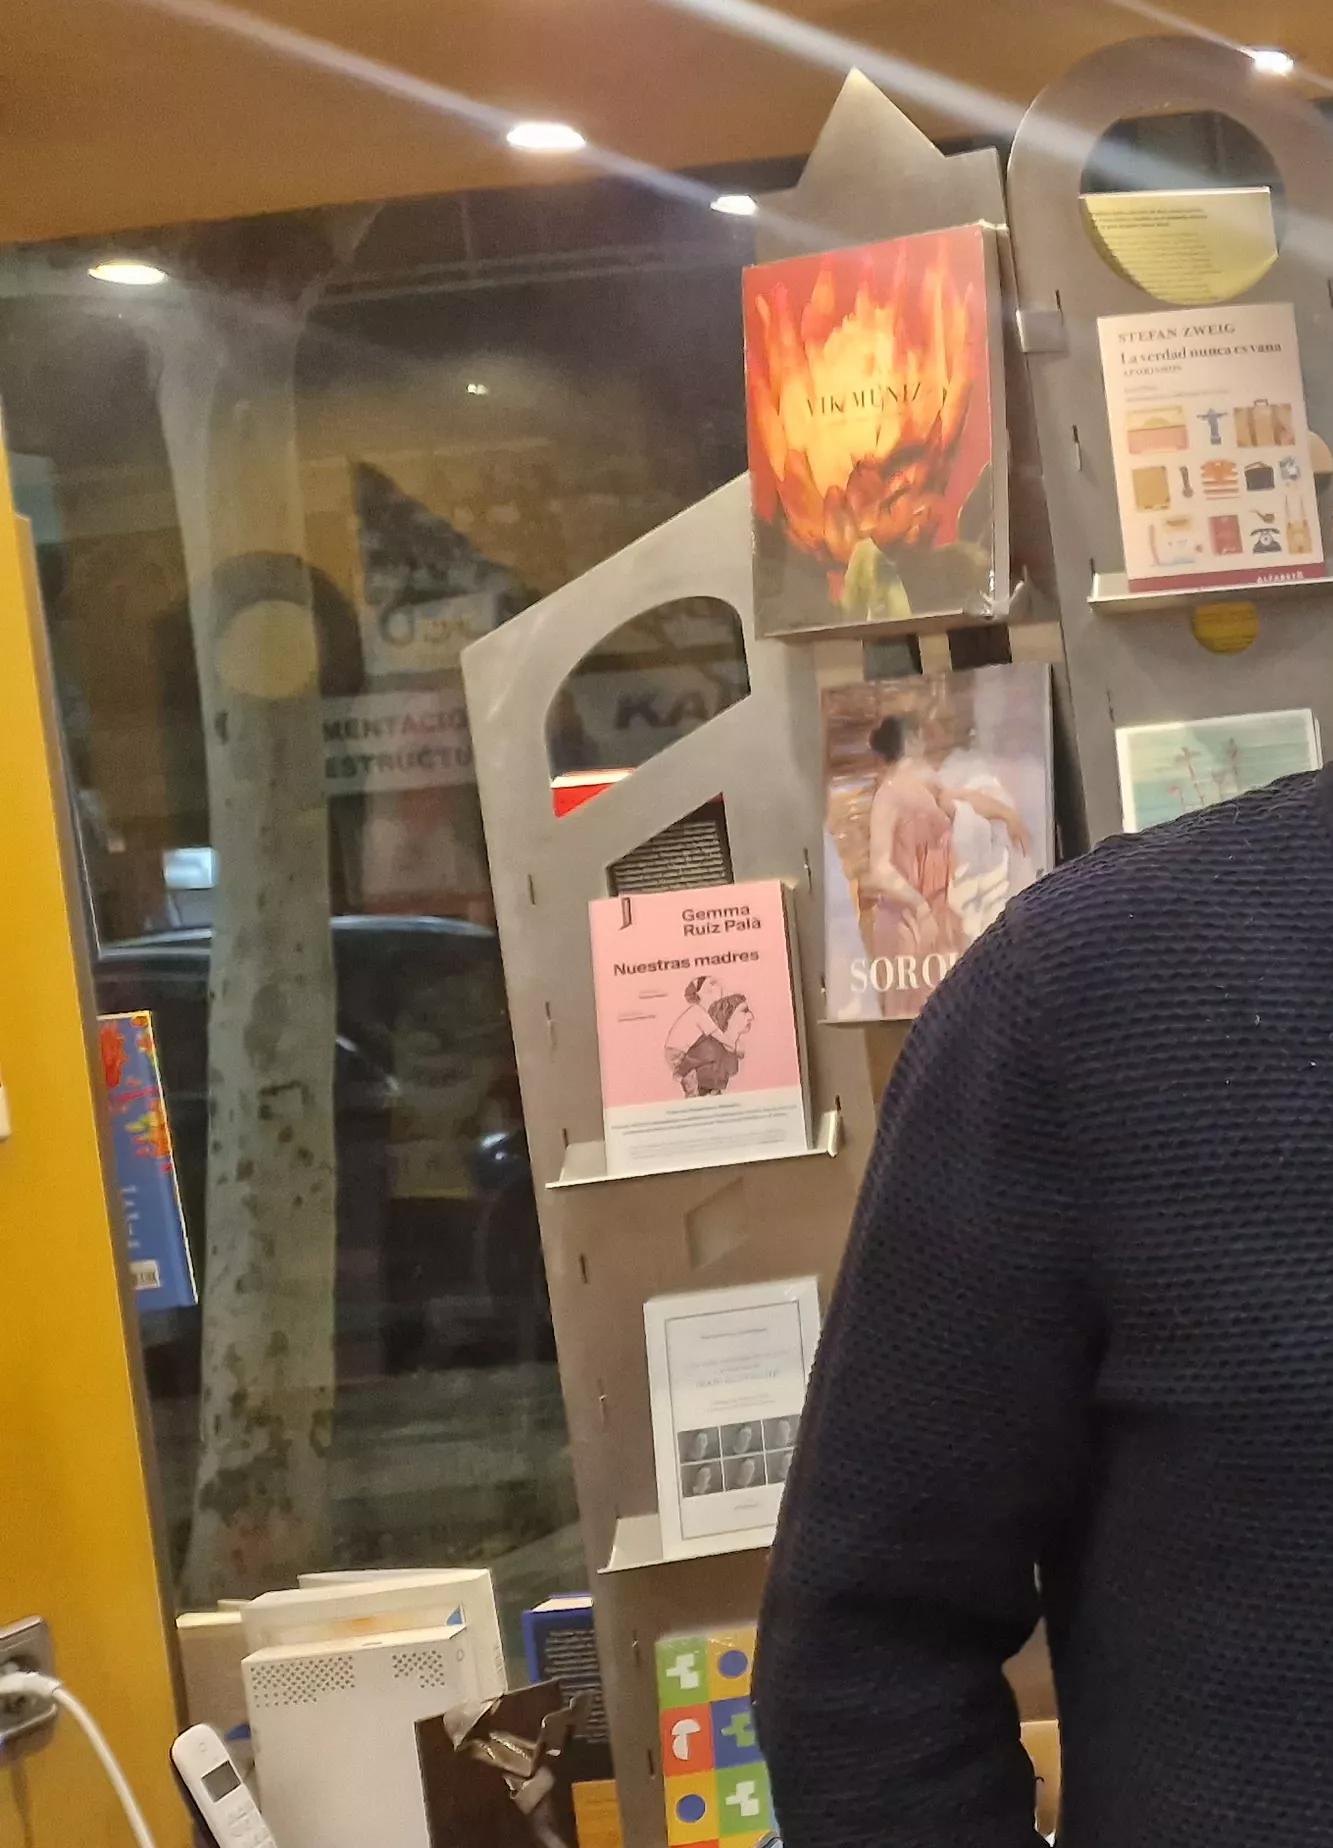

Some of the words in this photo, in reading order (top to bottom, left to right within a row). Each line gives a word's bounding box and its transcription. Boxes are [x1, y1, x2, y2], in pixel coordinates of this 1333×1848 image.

[1118, 326, 1178, 343] STEFAN
[1183, 322, 1236, 338] ZWEIG
[1121, 352, 1137, 365] La
[1140, 346, 1187, 363] verdad
[1190, 346, 1231, 359] nunca
[1250, 342, 1282, 354] vana
[681, 904, 751, 922] Gemma
[683, 922, 721, 937] Ruiz
[724, 916, 762, 933] Palà
[613, 956, 691, 977] Nuestras
[694, 950, 760, 968] madres
